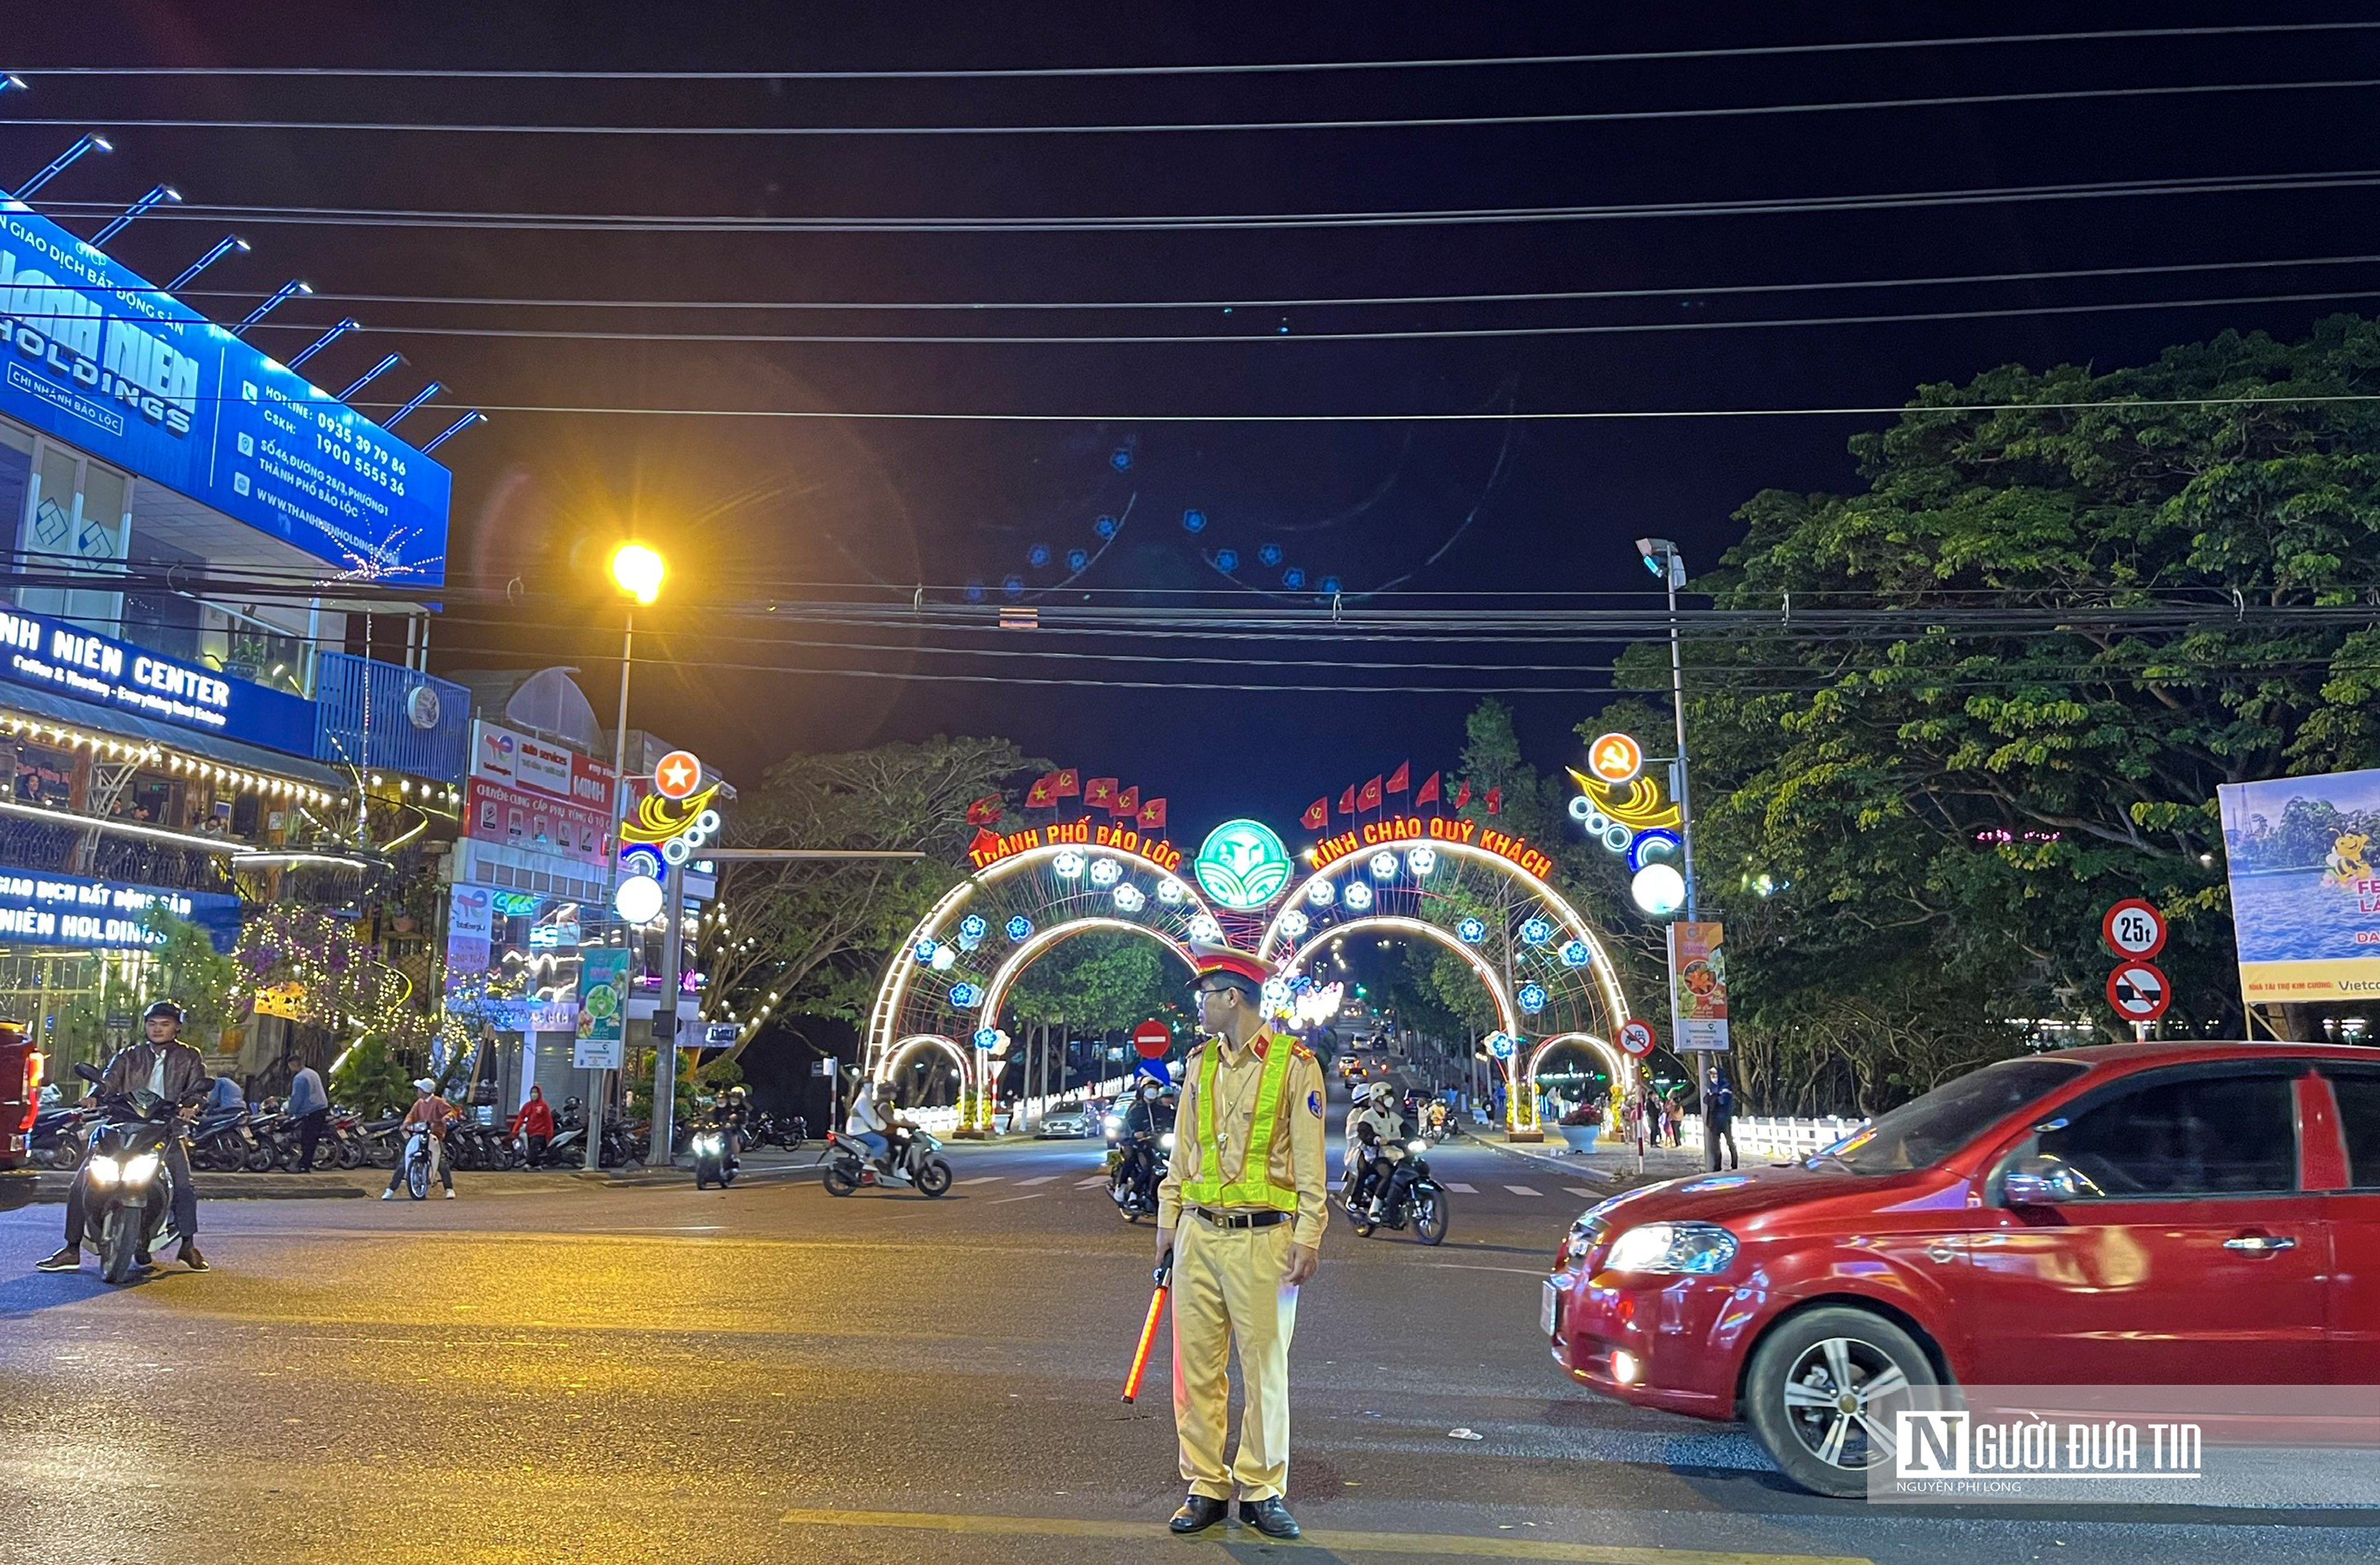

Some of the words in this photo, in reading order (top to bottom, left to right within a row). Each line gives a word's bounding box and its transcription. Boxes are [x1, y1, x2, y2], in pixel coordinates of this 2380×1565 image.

[10, 221, 46, 252] GIAO
[49, 245, 84, 277] DỊCH
[12, 370, 32, 388] CHI
[264, 410, 296, 434] CSKH:
[317, 434, 350, 465] 1900
[355, 456, 387, 487] 5555
[390, 478, 405, 496] 36
[265, 385, 313, 421] HOTLINE:
[317, 412, 351, 443] 0935
[355, 434, 371, 454] 39
[373, 445, 388, 465] 79
[391, 456, 407, 476] 86
[259, 458, 294, 485] THÀNH
[295, 479, 318, 496] PHỐ
[53, 629, 123, 677] NIÊN
[134, 656, 230, 708] CENTER
[54, 667, 64, 683] &
[1046, 815, 1092, 844] PHỐ
[1095, 821, 1139, 851] BẢO
[1309, 831, 1359, 871] KÍNH
[1363, 814, 1422, 844] CHÀO
[1429, 818, 1474, 843] QUÝ
[1479, 828, 1554, 879] KHÁCH
